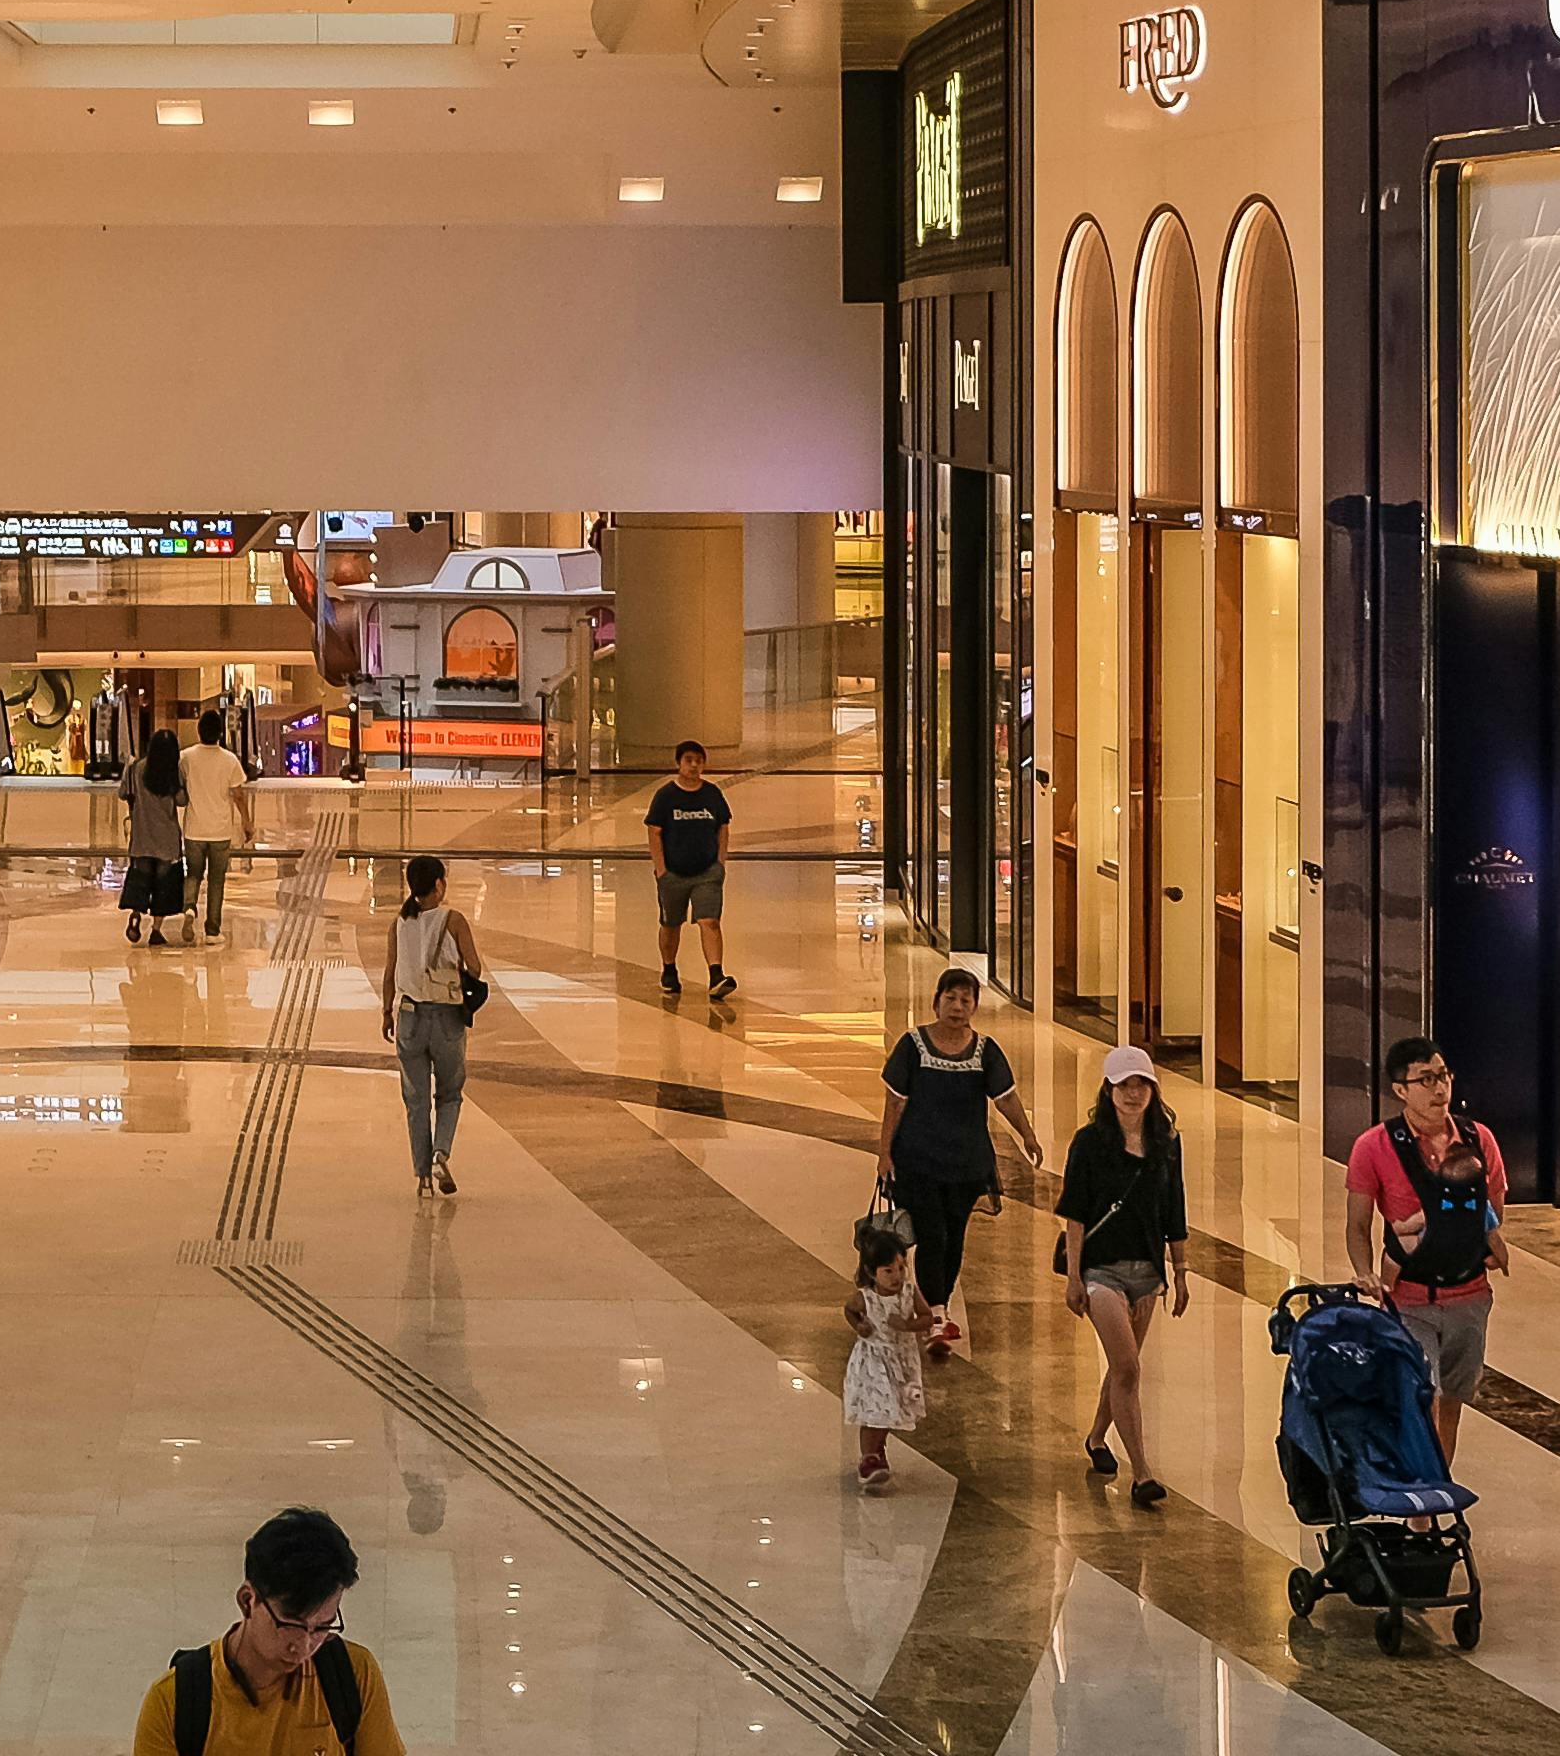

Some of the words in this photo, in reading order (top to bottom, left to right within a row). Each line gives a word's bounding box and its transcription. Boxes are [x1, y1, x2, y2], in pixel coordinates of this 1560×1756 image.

[1119, 7, 1207, 112] FRED
[386, 730, 431, 744] Wome
[435, 732, 445, 744] to
[448, 731, 498, 746] Cinematic
